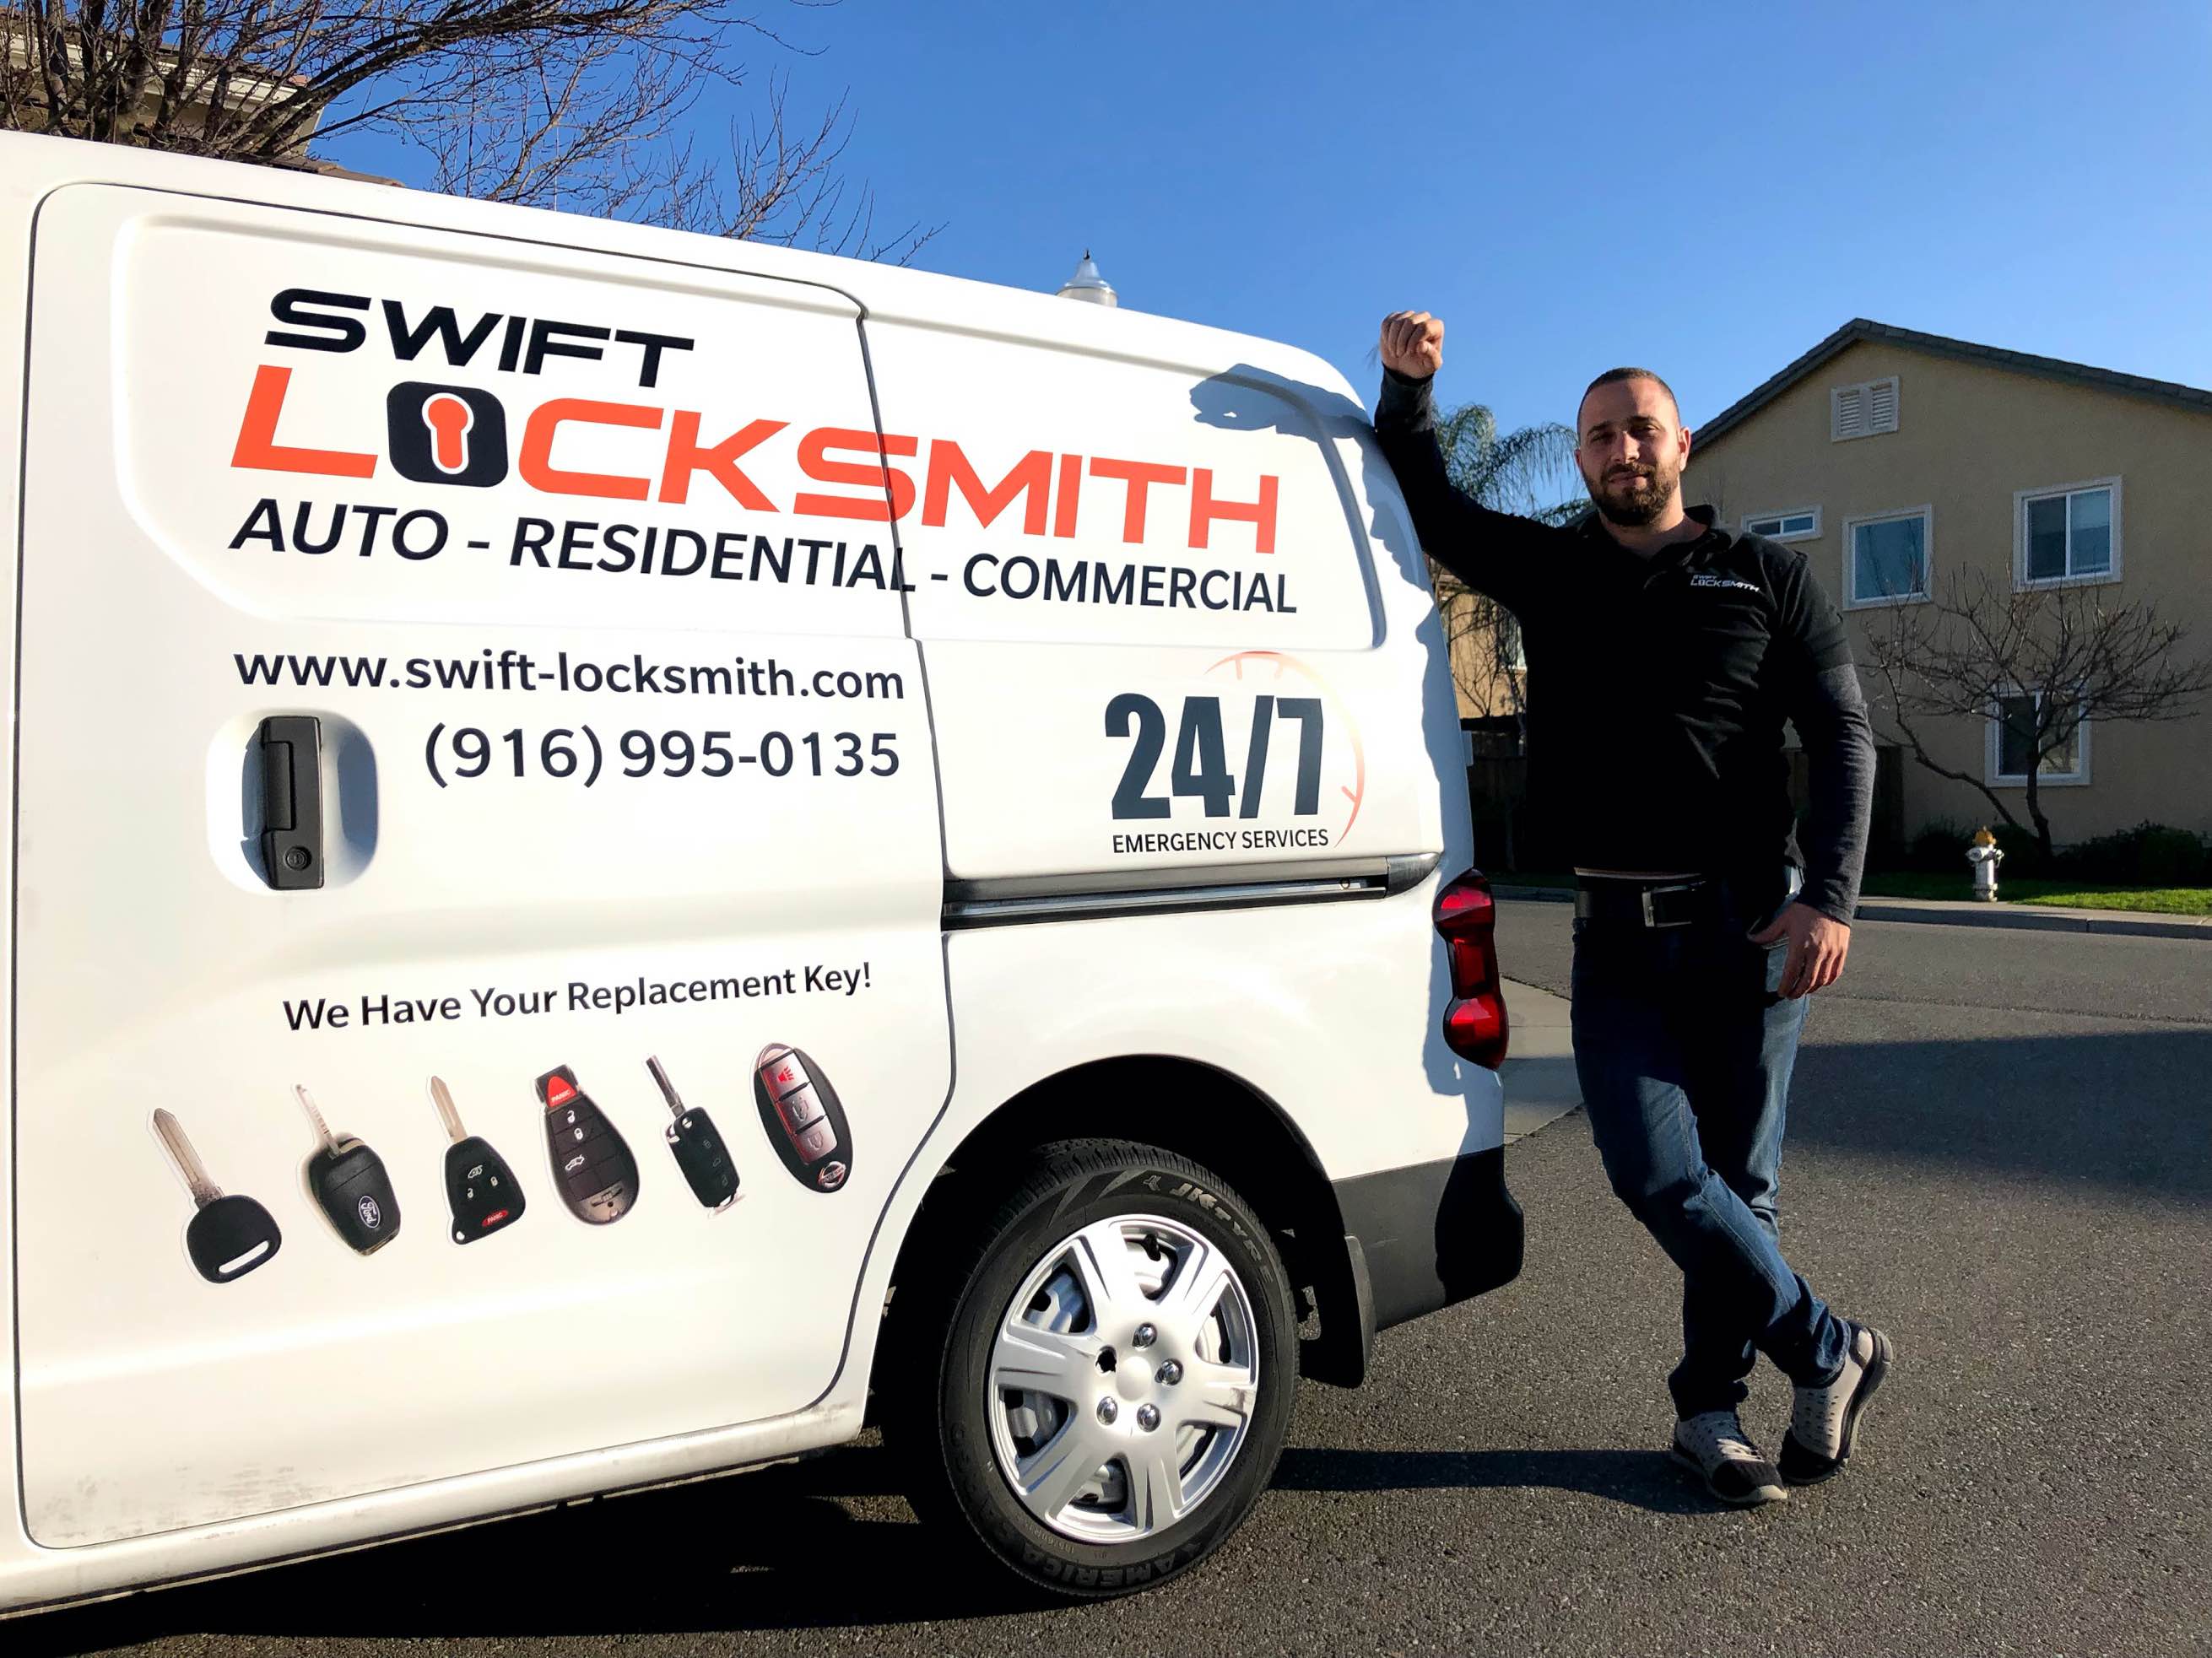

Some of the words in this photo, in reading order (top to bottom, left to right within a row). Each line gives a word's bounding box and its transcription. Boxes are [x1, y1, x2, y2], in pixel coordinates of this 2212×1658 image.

[265, 289, 695, 388] SWIFT
[230, 365, 1279, 554] LOCKSMITH
[229, 499, 448, 560] AUTO
[510, 517, 917, 592] RESIDENTIAL
[964, 554, 1297, 613] COMMERCIAL
[1690, 579, 1760, 591] LOCKSMITH
[234, 649, 903, 699] www.swift-locksmith.com
[426, 723, 603, 789] (916)
[620, 730, 900, 778] 995-0135
[1106, 694, 1324, 819] 24/7
[1113, 832, 1237, 854] EMERGENCY
[1241, 829, 1328, 849] SERVICES
[284, 999, 349, 1031] We
[362, 995, 462, 1026] Have
[470, 988, 558, 1018] Your
[568, 969, 797, 1014] Replacement
[805, 963, 871, 997] Key!
[361, 1202, 377, 1223] Ford
